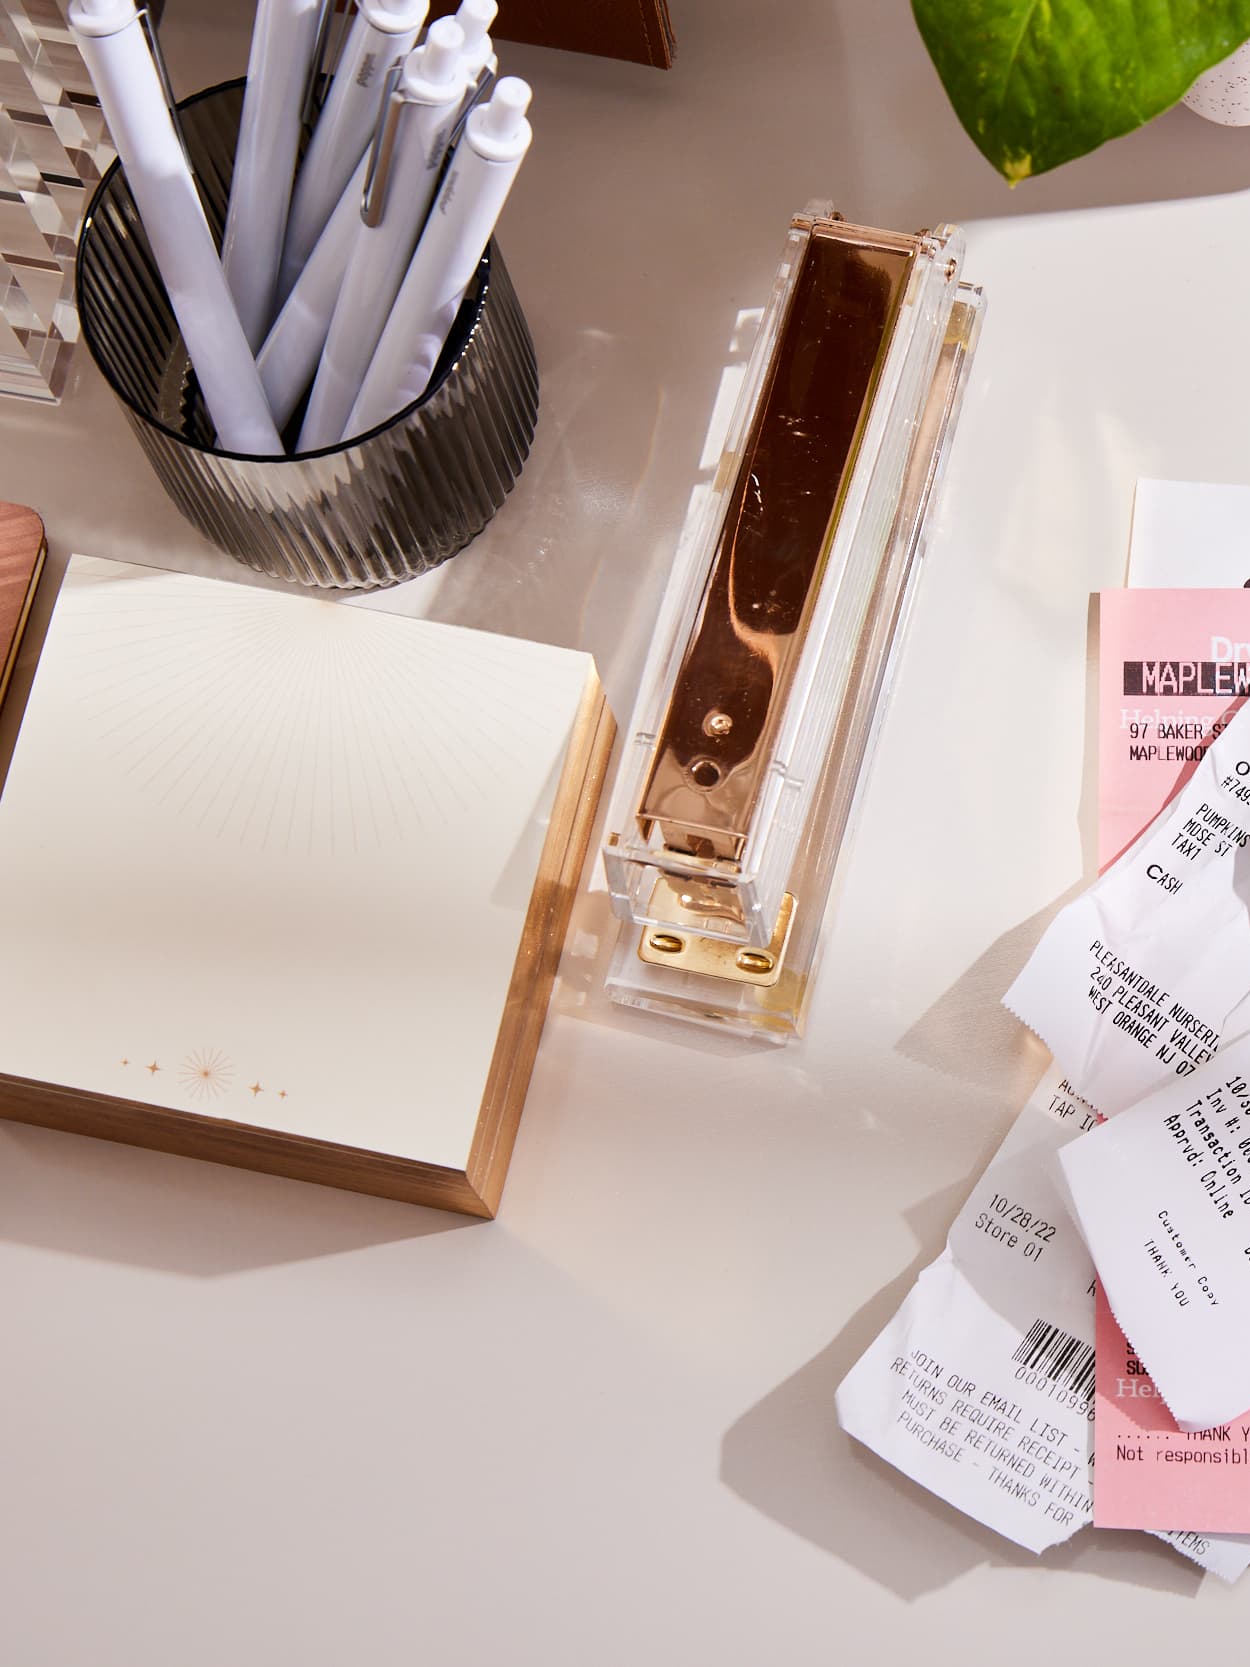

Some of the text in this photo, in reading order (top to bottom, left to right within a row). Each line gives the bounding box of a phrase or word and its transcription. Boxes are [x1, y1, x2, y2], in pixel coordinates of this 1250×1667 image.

[1130, 723, 1148, 739] 97
[1157, 723, 1203, 740] BAKER
[1171, 833, 1202, 861] TAX1
[1183, 818, 1233, 857] MDSE ST
[1146, 864, 1184, 895] CASH
[1090, 940, 1170, 1007] PLEASANTDALE
[1090, 966, 1113, 991] 240
[1112, 985, 1170, 1032] PLEASANT
[1088, 985, 1113, 1014] WEST
[1112, 1011, 1157, 1049] ORANGE
[1155, 1044, 1177, 1064] NJ
[1049, 1095, 1076, 1119] TAP
[1206, 1088, 1227, 1114] Inv
[1163, 1113, 1205, 1167] Apprvd:
[1200, 1170, 1234, 1219] Online
[1186, 1099, 1242, 1185] Transaction
[975, 1212, 1044, 1262] Store 01
[989, 1194, 1057, 1243] 10/28/22
[1158, 1210, 1197, 1269] Customer
[1144, 1239, 1190, 1307] THANK YOU
[889, 1357, 948, 1405] RETURNS
[950, 1399, 1016, 1442] REQUIRE
[1017, 1436, 1081, 1480] RECEIPT
[911, 1350, 944, 1379] JOIN
[947, 1374, 976, 1397] OUR
[979, 1391, 1025, 1424] EMAIL
[1029, 1418, 1069, 1448] LIST
[897, 1410, 964, 1463] PURCHASE
[987, 1466, 1041, 1508] THANKS
[1044, 1502, 1074, 1527] FOR
[901, 1389, 1094, 1513] MUST BE RETURNED WITHIN
[1117, 1445, 1144, 1461] Not
